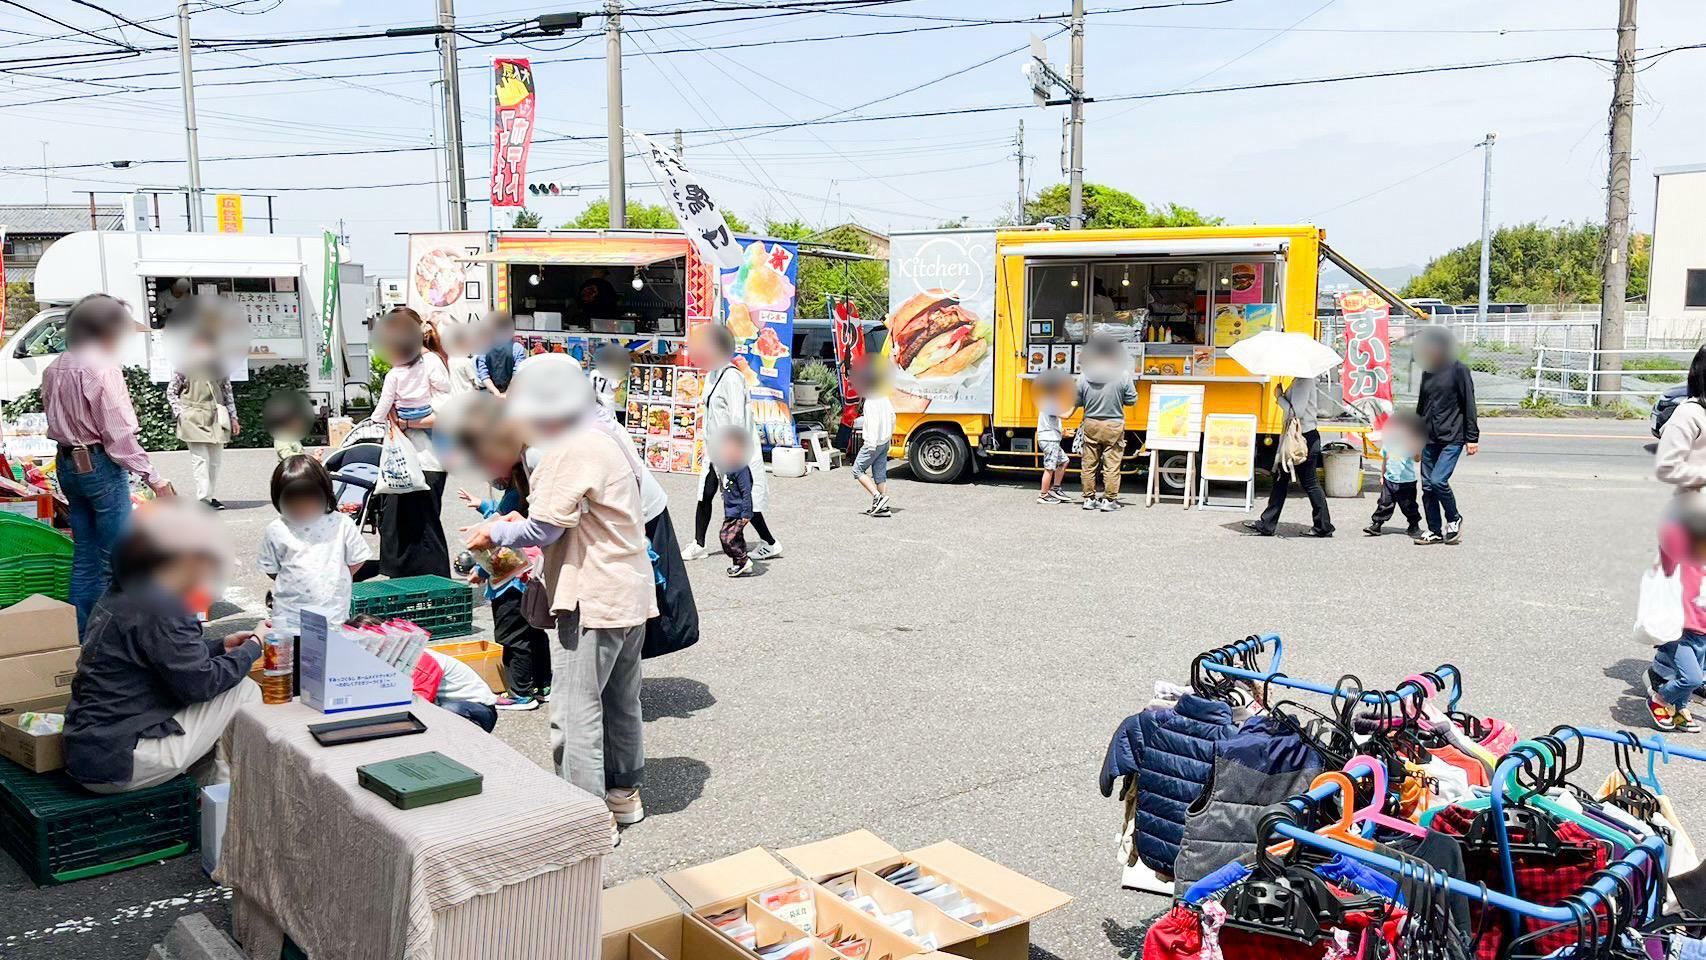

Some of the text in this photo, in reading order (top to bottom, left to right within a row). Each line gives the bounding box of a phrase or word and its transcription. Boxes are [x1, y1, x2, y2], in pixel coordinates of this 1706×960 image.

[768, 247, 789, 272] 氷
[897, 254, 972, 279] Kitchen
[1344, 309, 1388, 396] すいか
[593, 376, 608, 393] 17
